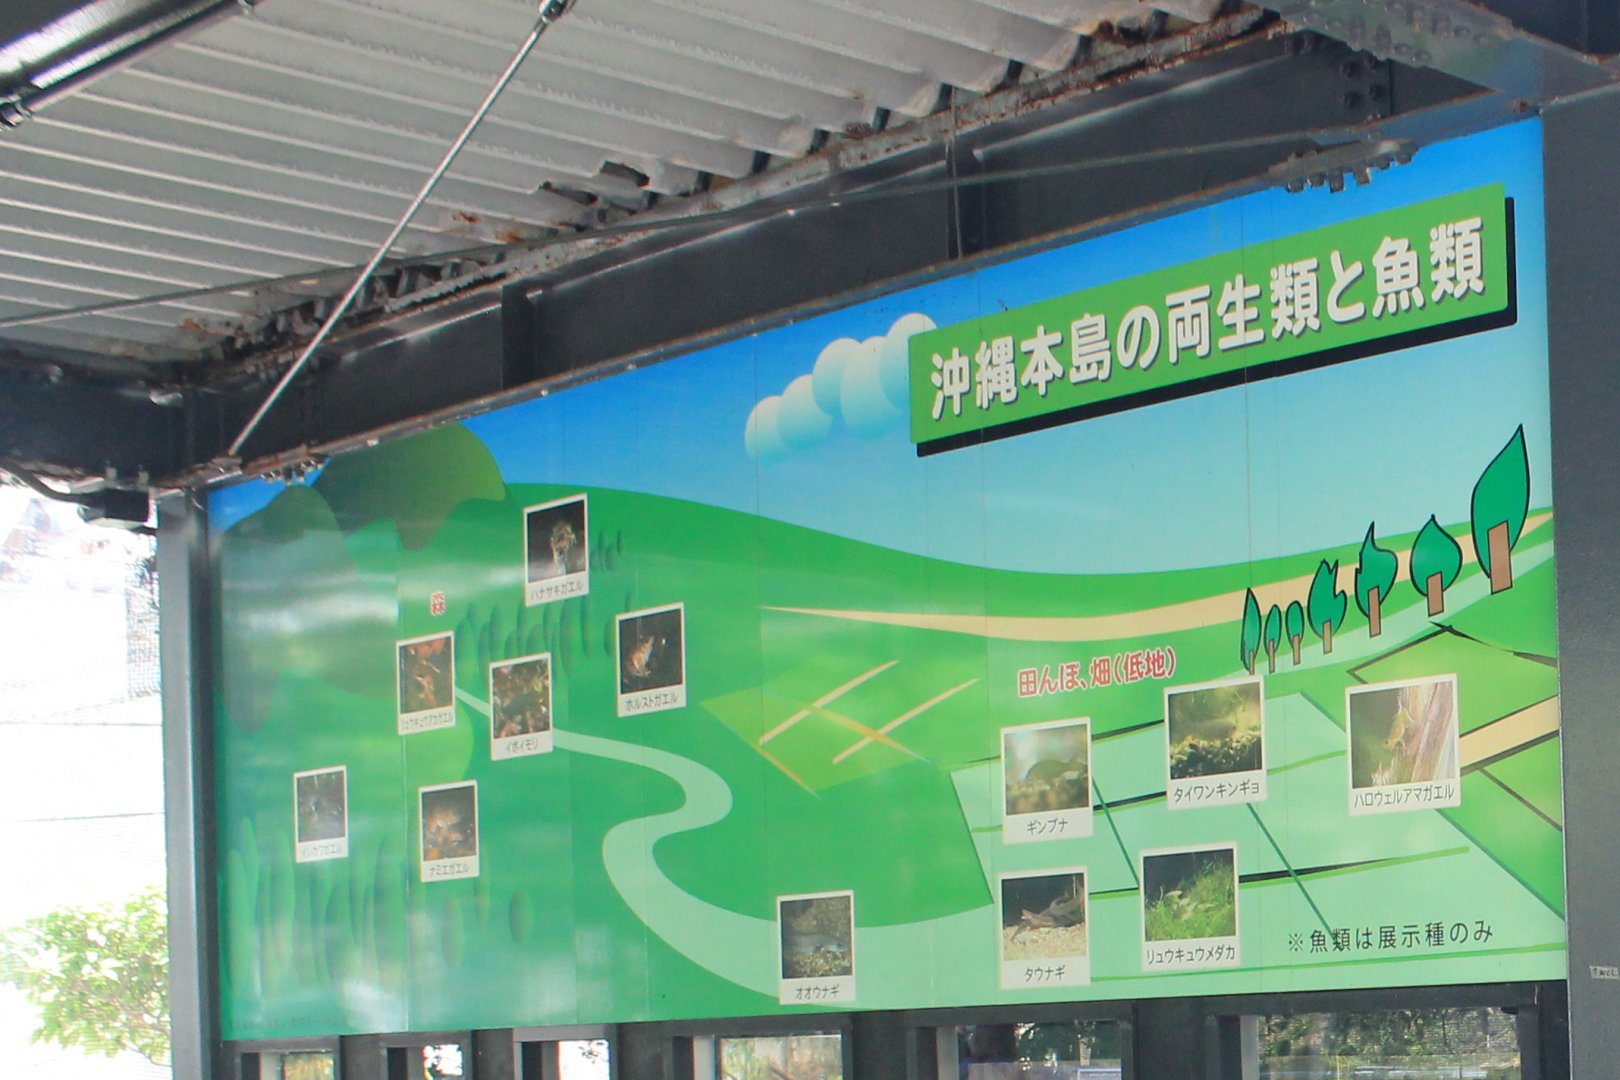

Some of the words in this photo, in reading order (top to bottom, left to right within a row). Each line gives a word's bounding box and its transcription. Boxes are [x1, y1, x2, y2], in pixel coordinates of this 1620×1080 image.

[930, 217, 1486, 421] 沖縄本島の両生類と魚類
[431, 592, 446, 616] 森
[1174, 779, 1261, 804] タイワンキンギョ
[1353, 784, 1455, 809] ハロウェルアマガエル
[1026, 817, 1069, 837] ギンブナ
[1146, 943, 1236, 965] リュウキュウメダカ
[1024, 964, 1066, 983] タウナギ
[795, 983, 840, 1000] オオウナギ
